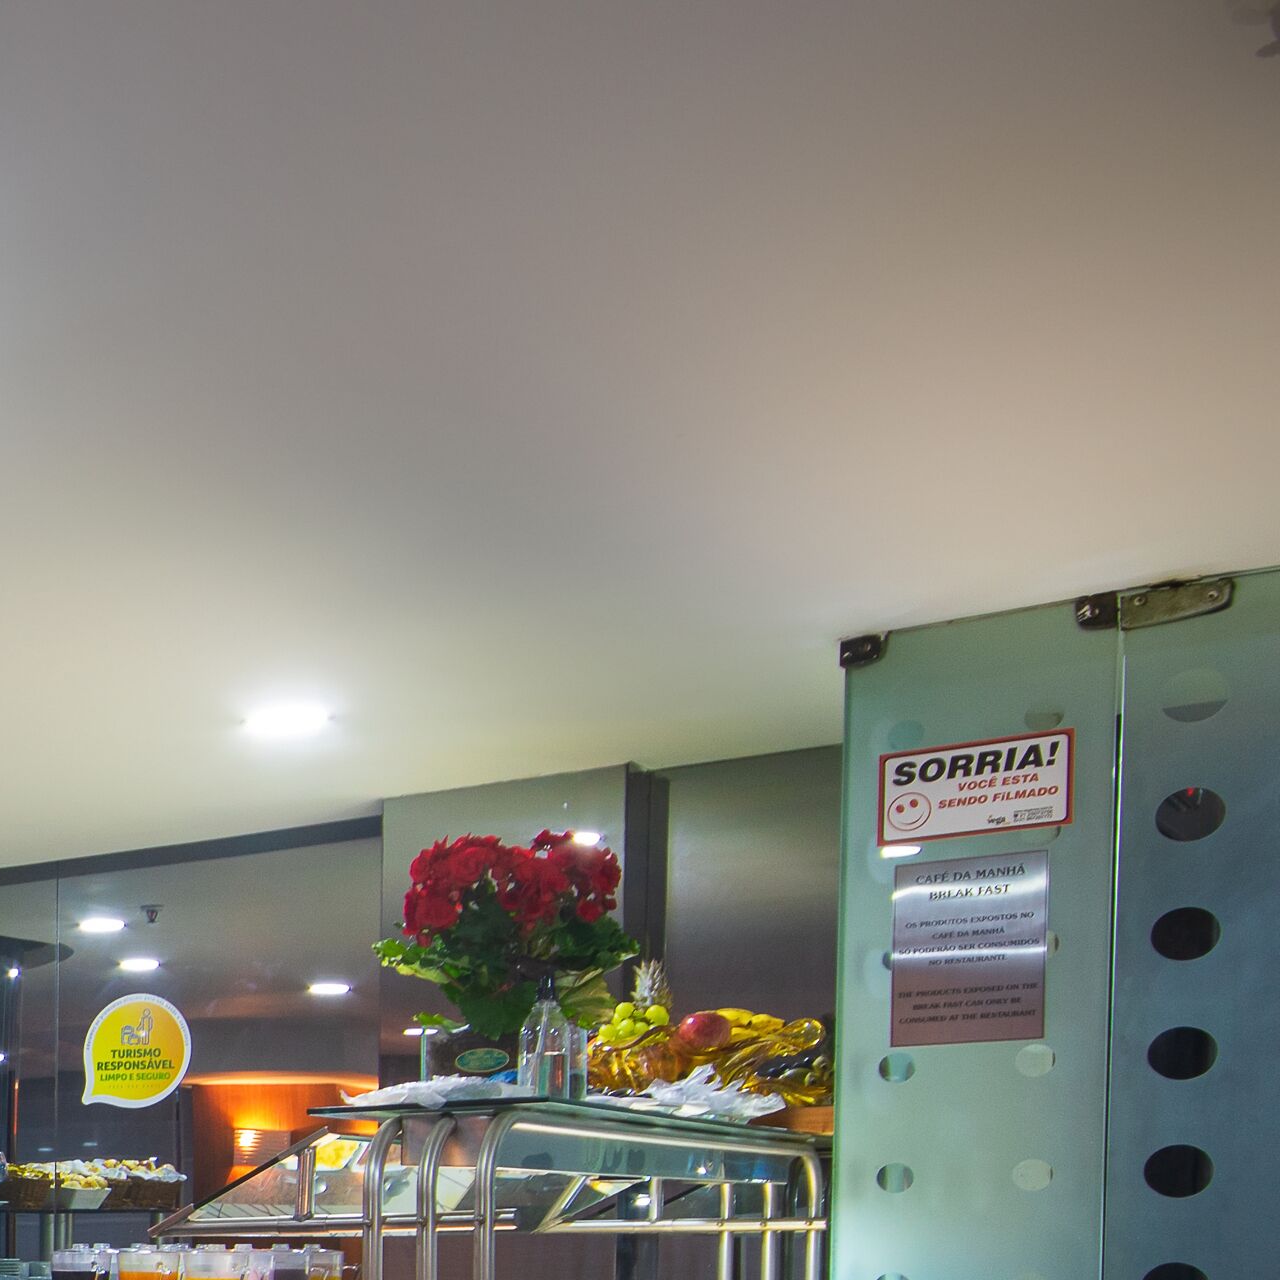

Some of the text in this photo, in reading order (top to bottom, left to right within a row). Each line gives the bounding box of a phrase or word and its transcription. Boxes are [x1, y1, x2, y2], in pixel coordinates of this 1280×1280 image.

[893, 741, 1060, 786] SORRIA!
[958, 776, 997, 792] VOCÊ
[938, 795, 989, 809] SENDO
[916, 871, 949, 884] CAFÉ
[953, 871, 971, 881] DA
[928, 884, 1012, 900] BREAK FAST
[905, 921, 917, 929] OS
[920, 916, 968, 929] PRODUTOS
[970, 912, 1018, 924] EXPOSTOS
[958, 942, 975, 950] SER
[977, 937, 1040, 949] CONSUMIDOS
[928, 958, 942, 967] NO
[111, 1047, 161, 1059] TURISMO
[97, 1058, 175, 1071] RESPONSÁVEL
[100, 1073, 128, 1082] LIMPO
[136, 1072, 171, 1081] SEGURO
